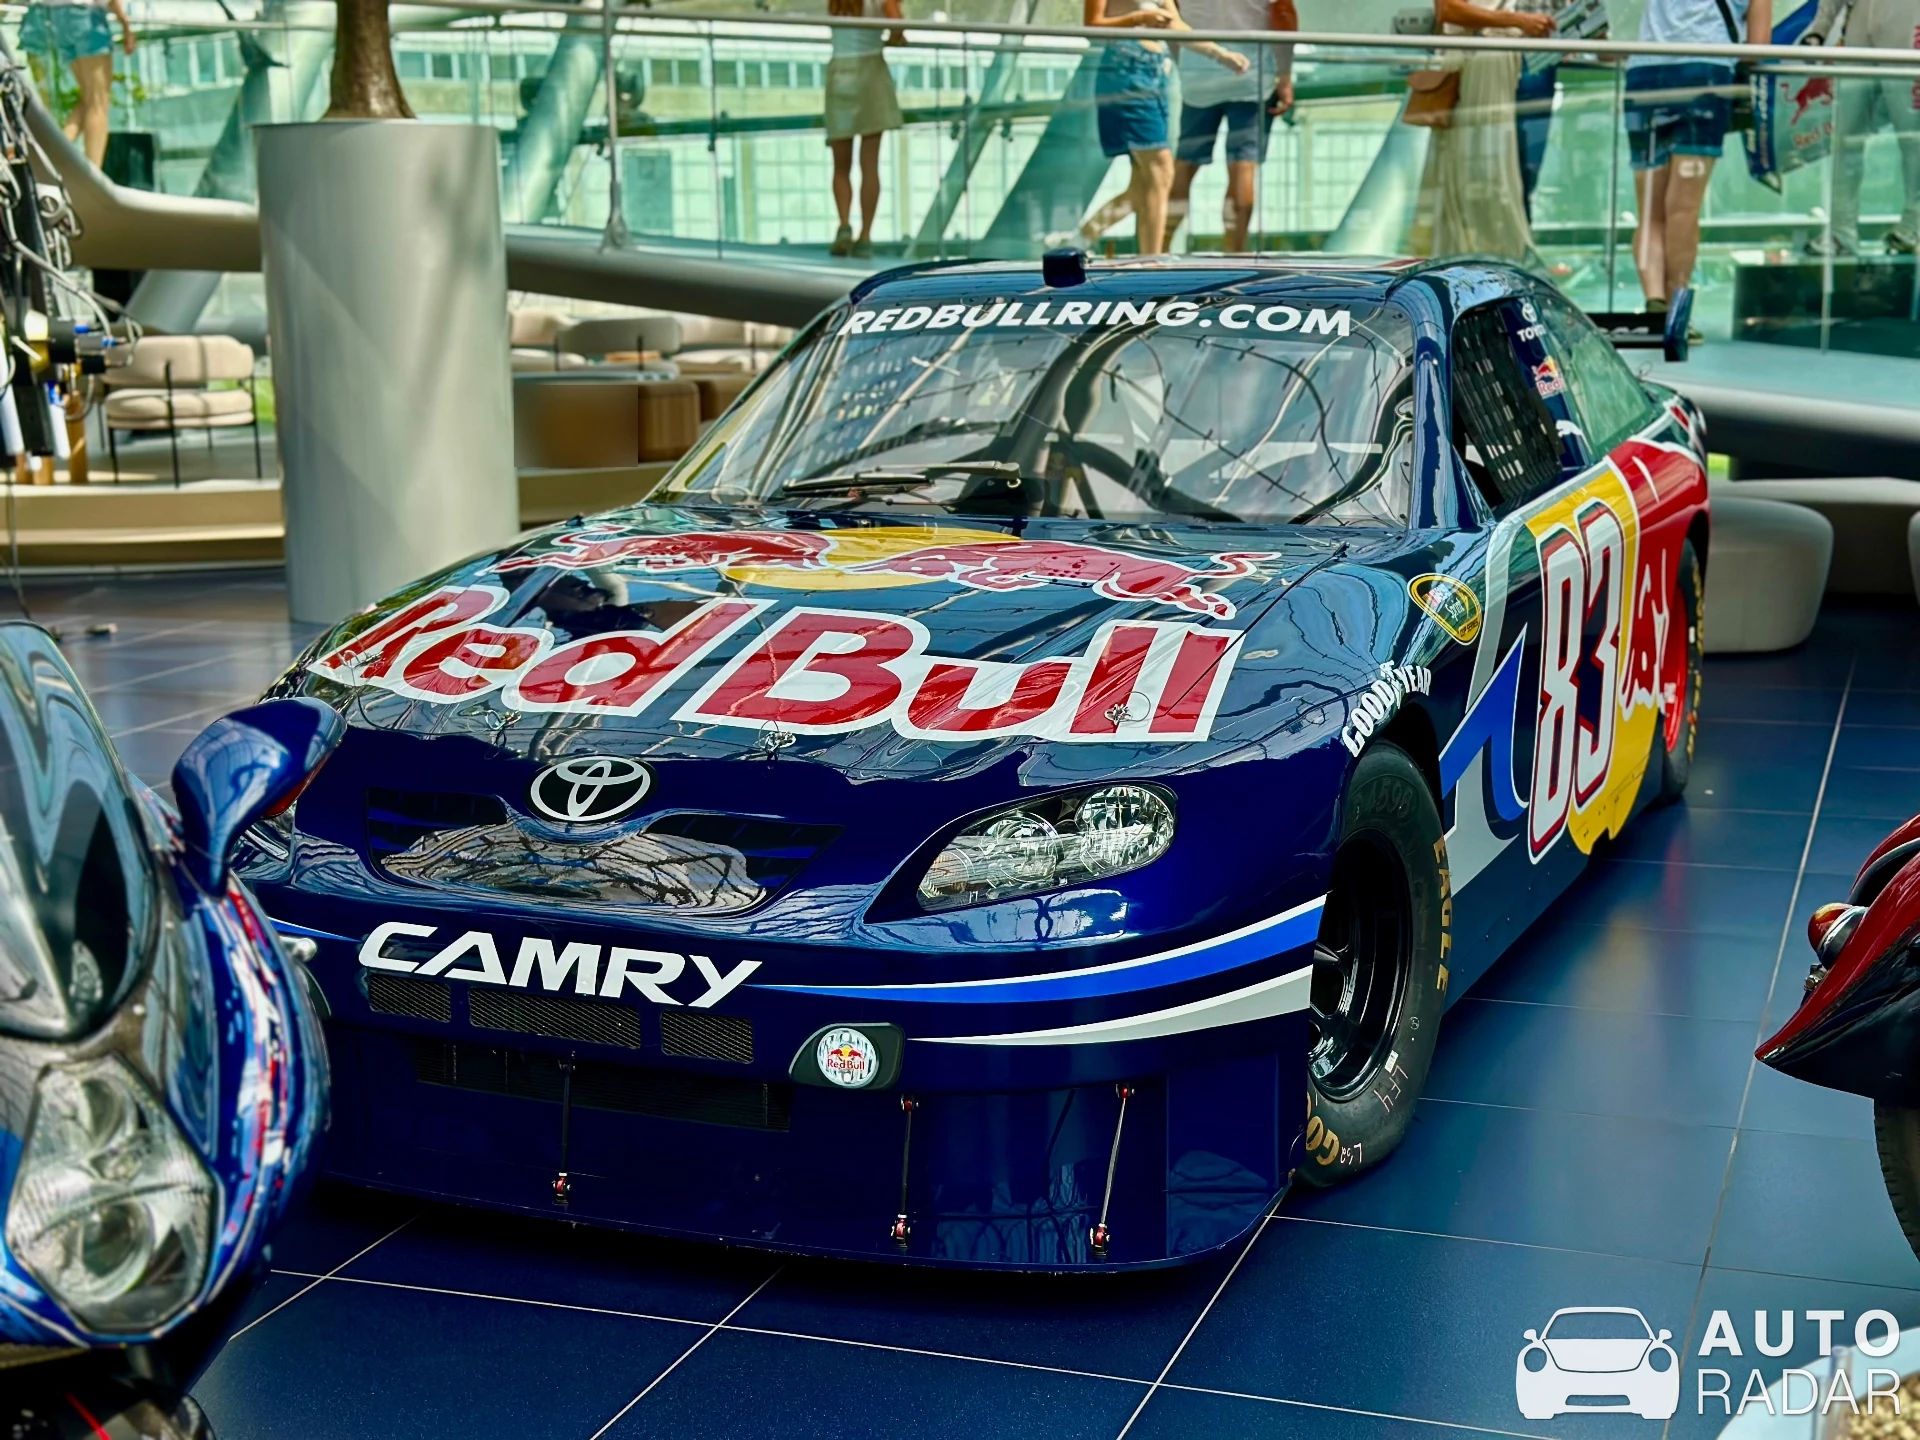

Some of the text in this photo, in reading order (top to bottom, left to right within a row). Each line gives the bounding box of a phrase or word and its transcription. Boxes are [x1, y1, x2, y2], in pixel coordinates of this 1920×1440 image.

[838, 300, 1351, 337] REDBULLRING.COM
[305, 585, 1243, 742] Red Bull
[1341, 660, 1432, 757] GOODYEAR
[1529, 498, 1624, 864] 83
[1432, 836, 1453, 992] EAGLE
[358, 921, 763, 1008] CAMRY
[827, 1058, 865, 1071] Red Bull
